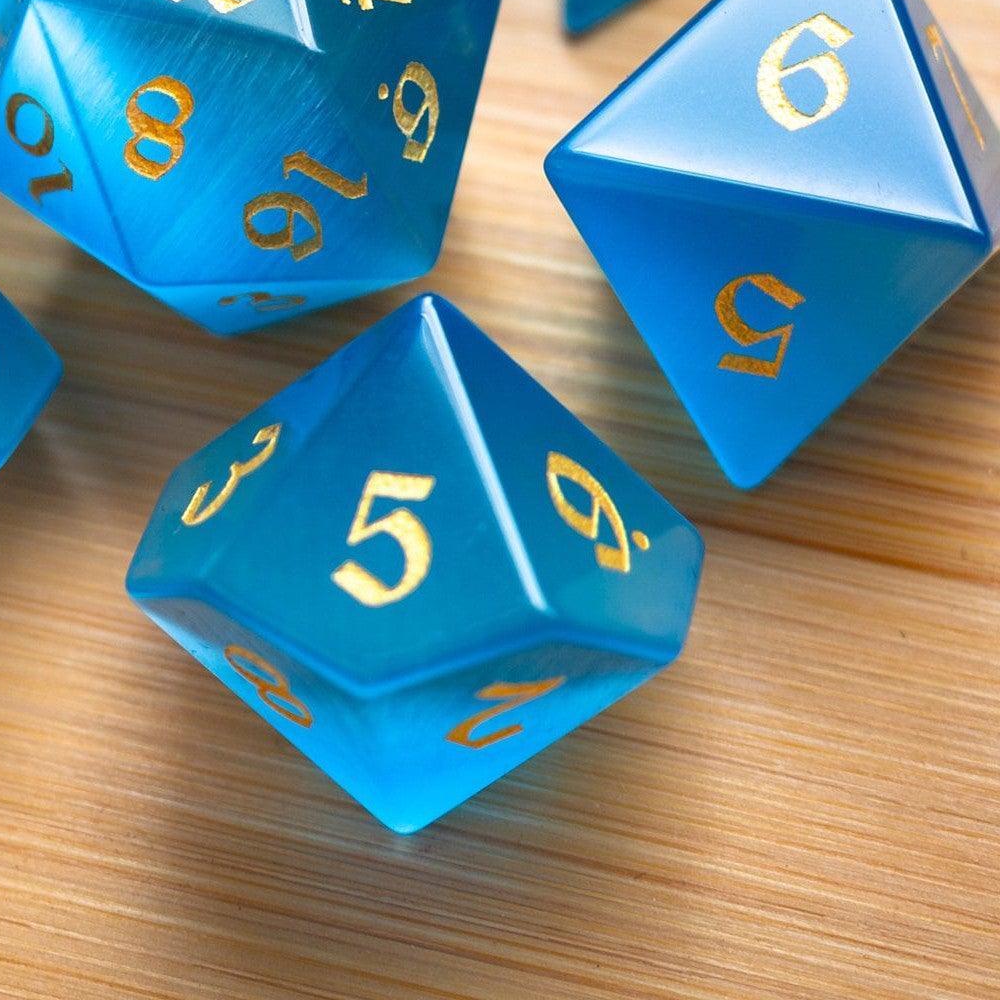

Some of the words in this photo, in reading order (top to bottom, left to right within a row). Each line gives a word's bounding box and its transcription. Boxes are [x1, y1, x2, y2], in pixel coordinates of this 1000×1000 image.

[123, 74, 195, 181] 8
[755, 11, 854, 132] 6
[5, 91, 74, 206] 10
[242, 149, 369, 262] 16
[714, 273, 806, 380] 5
[330, 470, 436, 608] 5
[223, 644, 313, 729] 8
